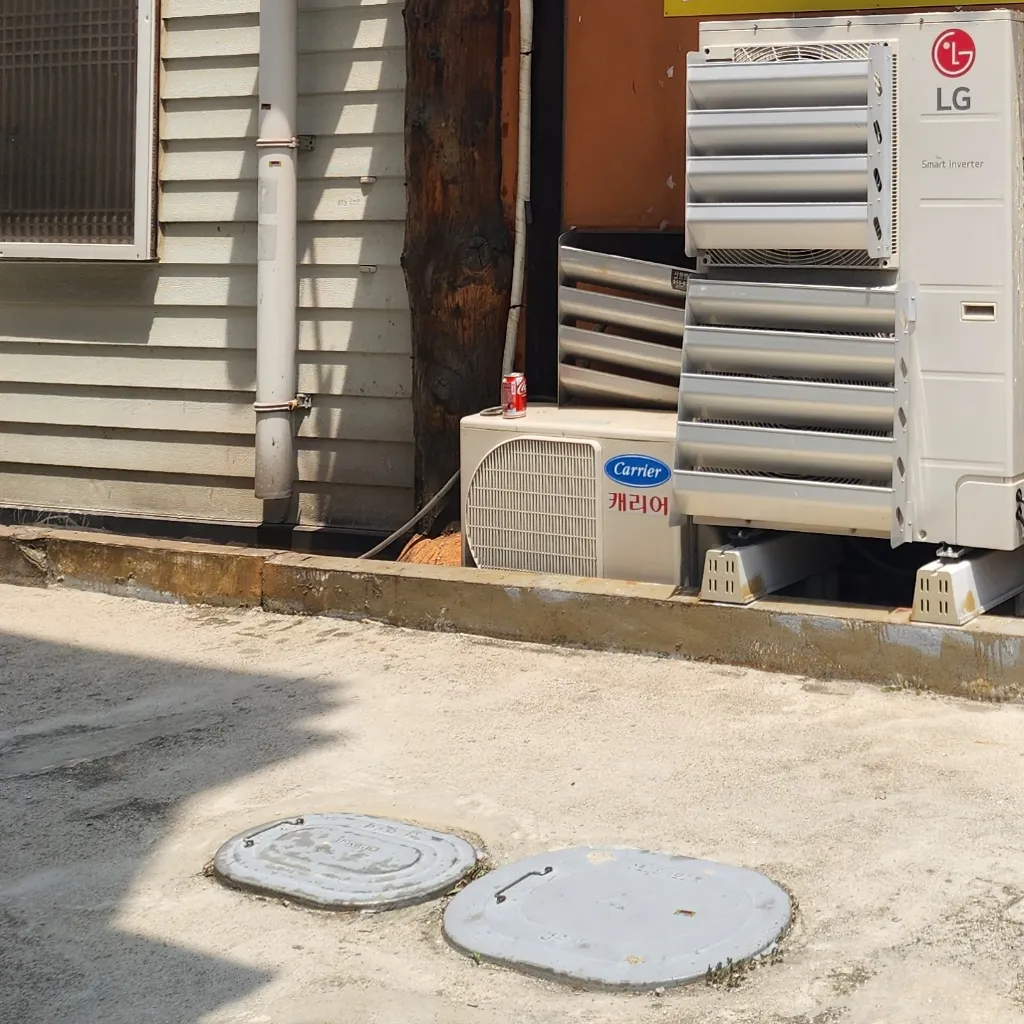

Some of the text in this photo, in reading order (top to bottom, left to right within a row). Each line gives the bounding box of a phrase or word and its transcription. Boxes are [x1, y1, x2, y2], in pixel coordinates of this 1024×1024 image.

[936, 86, 971, 111] LG
[921, 159, 984, 169] Smart Inverter
[613, 461, 663, 479] Carrier
[608, 492, 668, 516] 캐리어
